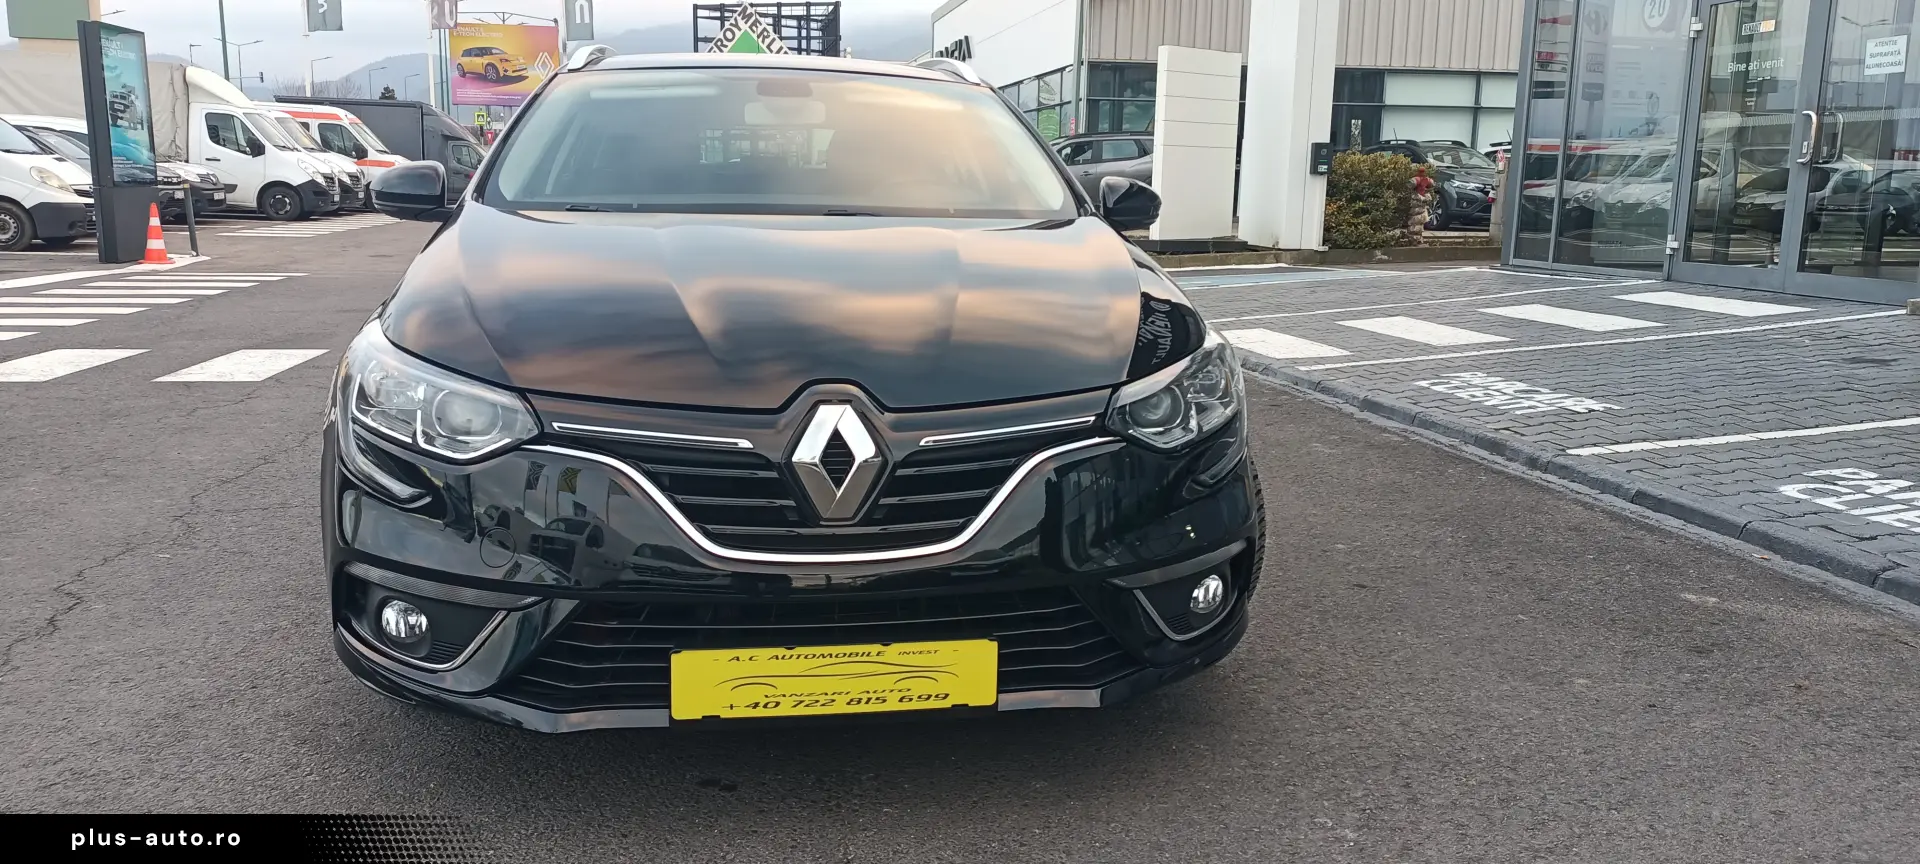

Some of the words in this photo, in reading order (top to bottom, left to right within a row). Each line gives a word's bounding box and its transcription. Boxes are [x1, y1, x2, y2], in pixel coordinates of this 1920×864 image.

[1727, 62, 1747, 73] Bine
[1761, 57, 1785, 69] venit
[1777, 483, 1920, 533] CLIE
[728, 655, 760, 663] A.C
[767, 650, 887, 661] AUTOMOBILE
[763, 690, 851, 699] VANZARI
[857, 687, 912, 696] AUTO
[721, 700, 781, 711] +40
[790, 698, 836, 709] 722
[845, 695, 888, 706] 815
[897, 692, 951, 704] 699
